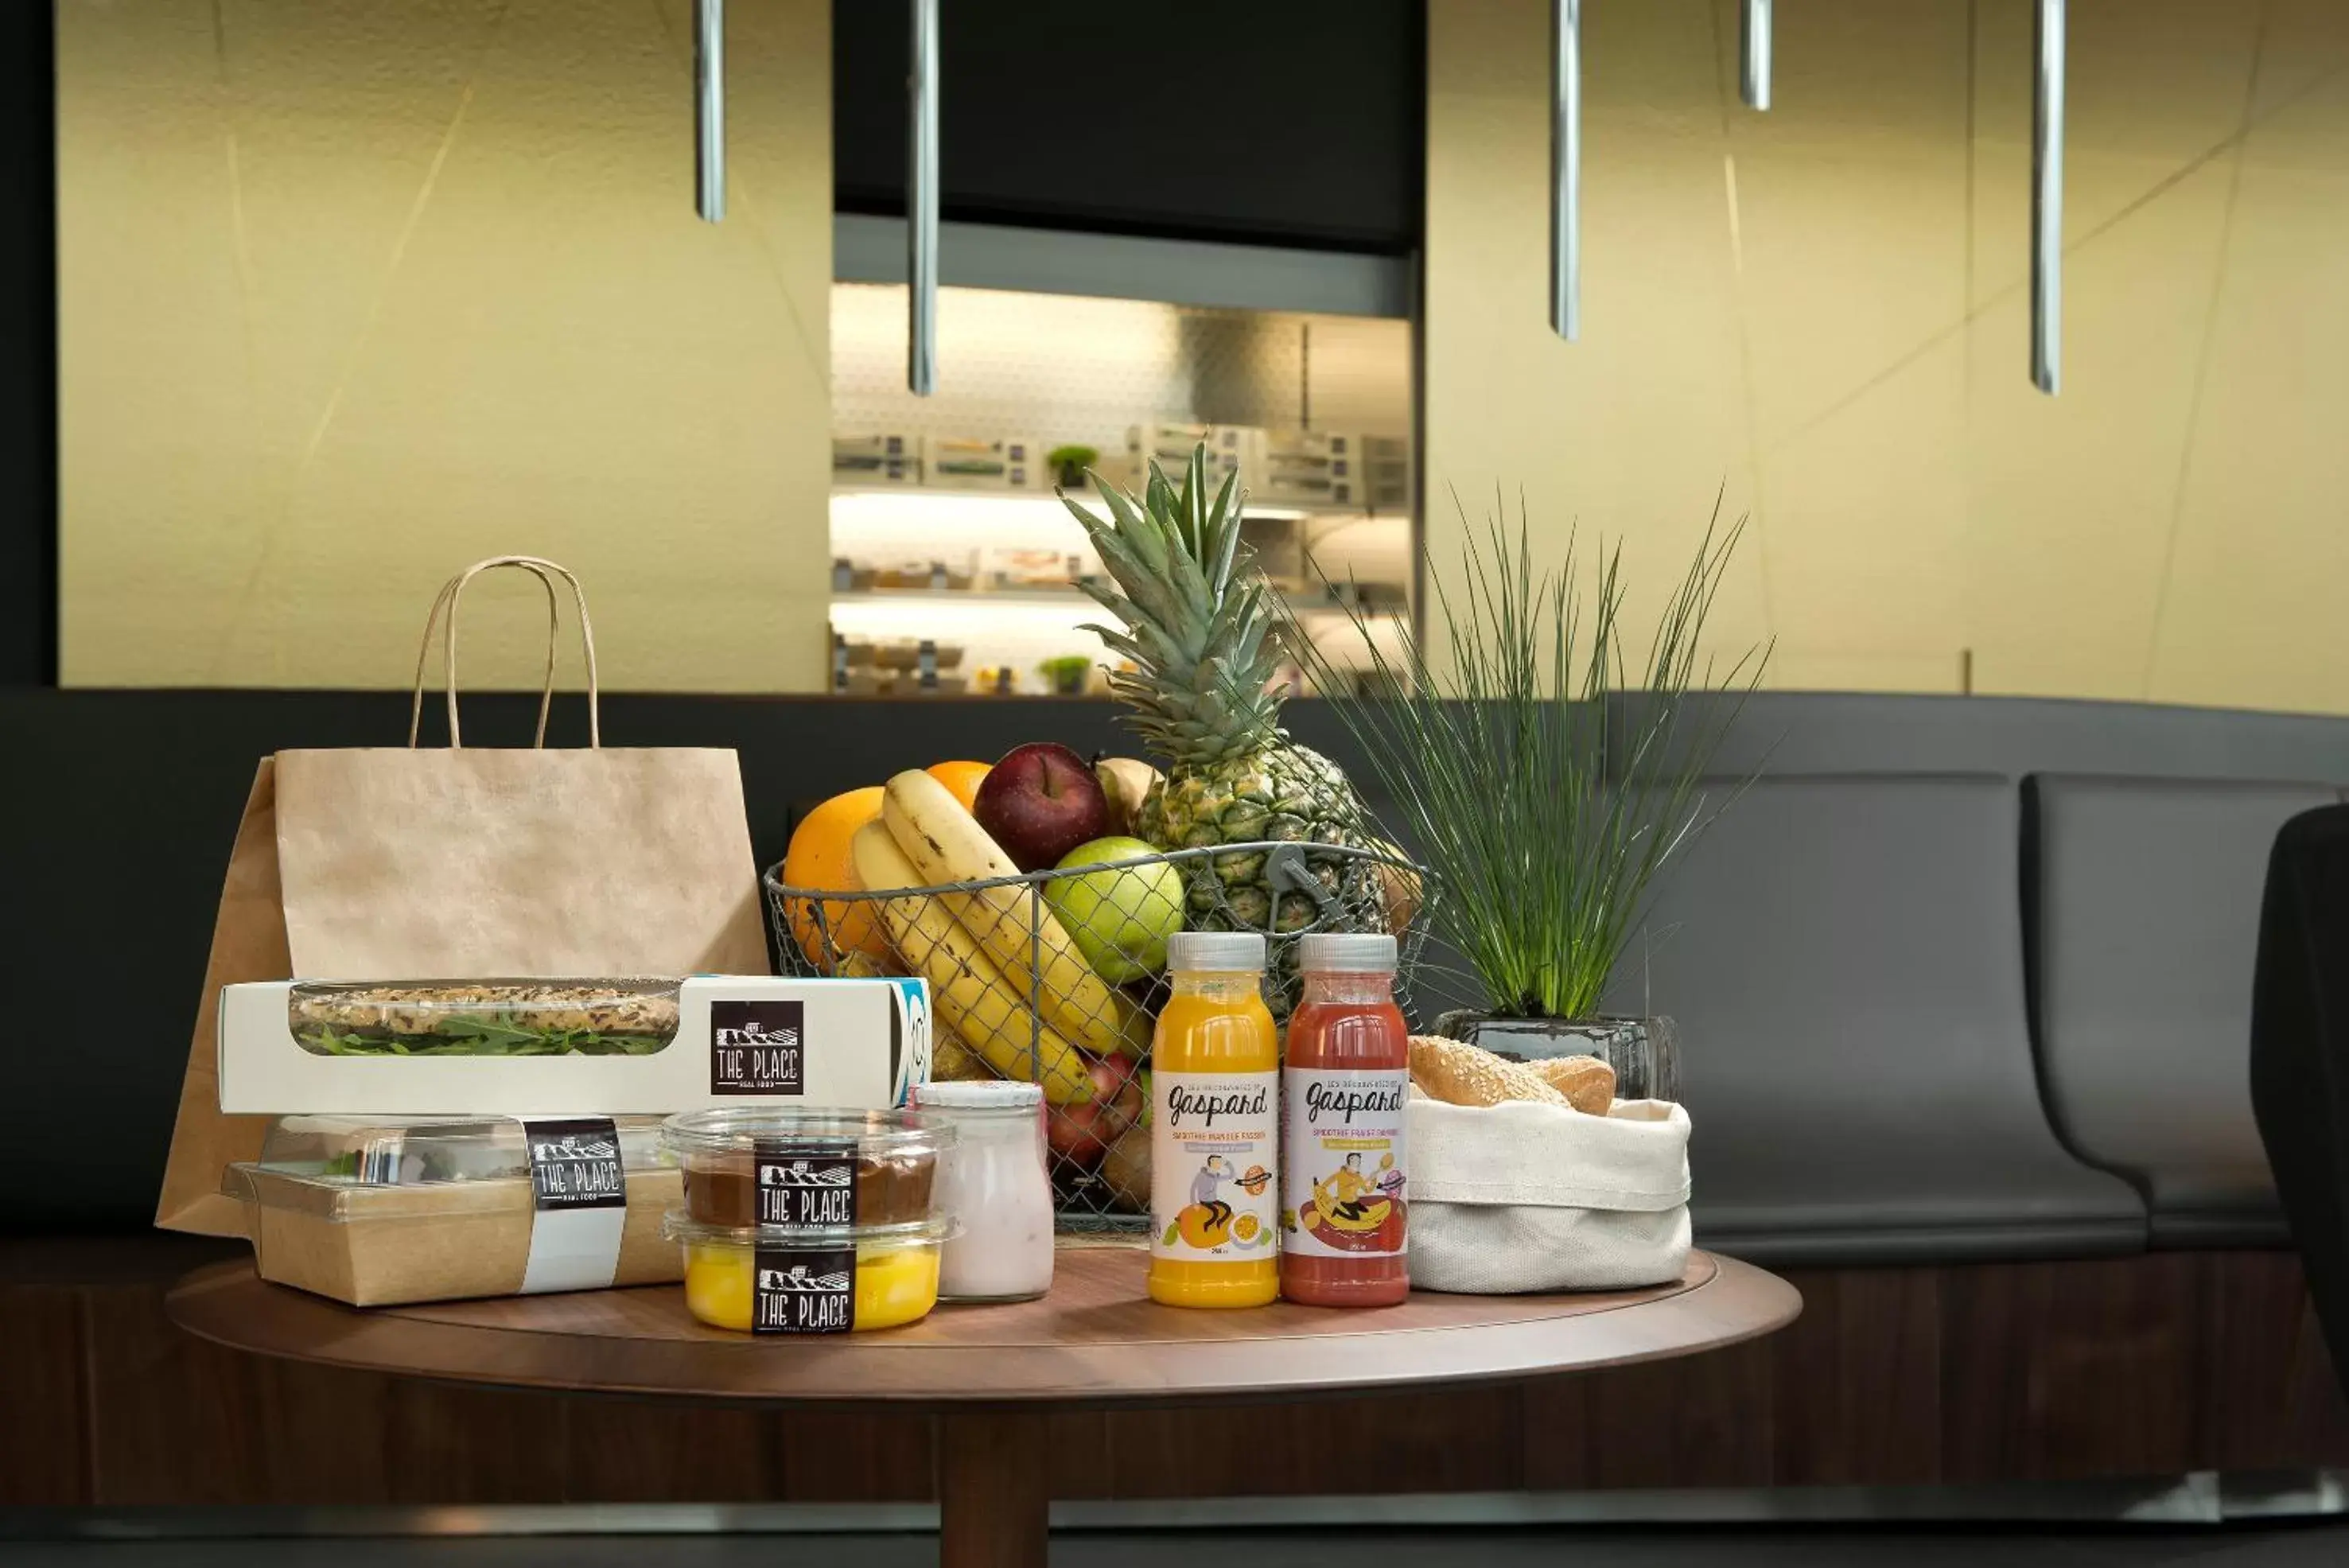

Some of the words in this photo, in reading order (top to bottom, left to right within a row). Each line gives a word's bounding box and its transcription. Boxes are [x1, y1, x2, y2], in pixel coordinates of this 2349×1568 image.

[717, 1049, 743, 1079] THE
[754, 1049, 798, 1079] PLACE
[538, 1164, 566, 1193] THE
[574, 1161, 619, 1192] PLACE
[760, 1189, 790, 1221] THE
[801, 1189, 851, 1223] PLACE
[760, 1293, 788, 1325] THE
[799, 1295, 848, 1327] PLACE
